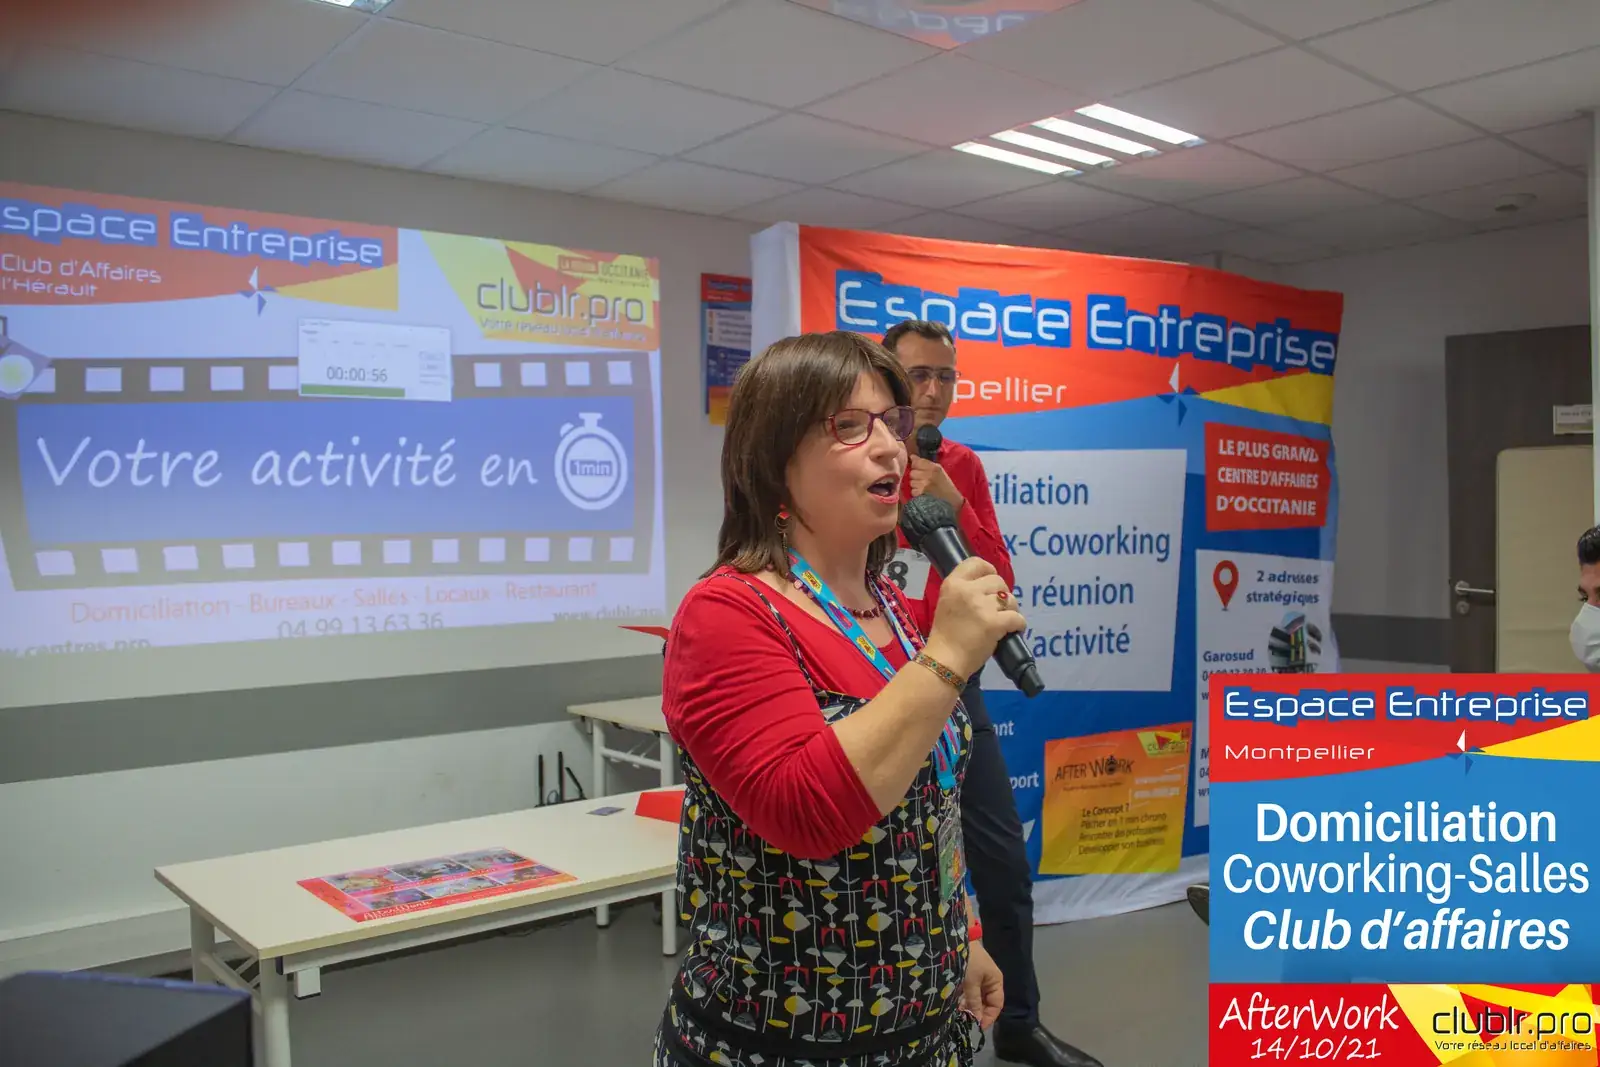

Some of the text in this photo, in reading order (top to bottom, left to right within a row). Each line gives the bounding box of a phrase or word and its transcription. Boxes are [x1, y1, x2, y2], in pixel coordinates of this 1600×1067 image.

[2, 205, 383, 265] space Entreprise
[1, 253, 163, 284] Club d'Affaires
[2, 276, 99, 296] l'Hérault
[477, 277, 645, 328] clublr.pro
[1089, 303, 1336, 369] Entreprise
[326, 366, 389, 383] 00:00:56
[36, 436, 539, 488] Votre activité en
[1218, 439, 1319, 462] LE PLUS GRAND
[571, 460, 611, 477] 1min
[1217, 466, 1319, 489] CENTRE D'AFFAIRES
[1216, 495, 1316, 516] D'OCCITANIE
[1256, 570, 1265, 582] 2
[71, 581, 598, 624] Domiciliation Bureaux Salles Locaux Restaurant
[1032, 576, 1134, 606] réunion
[1203, 649, 1254, 662] Garosud
[1055, 764, 1087, 781] AFTER
